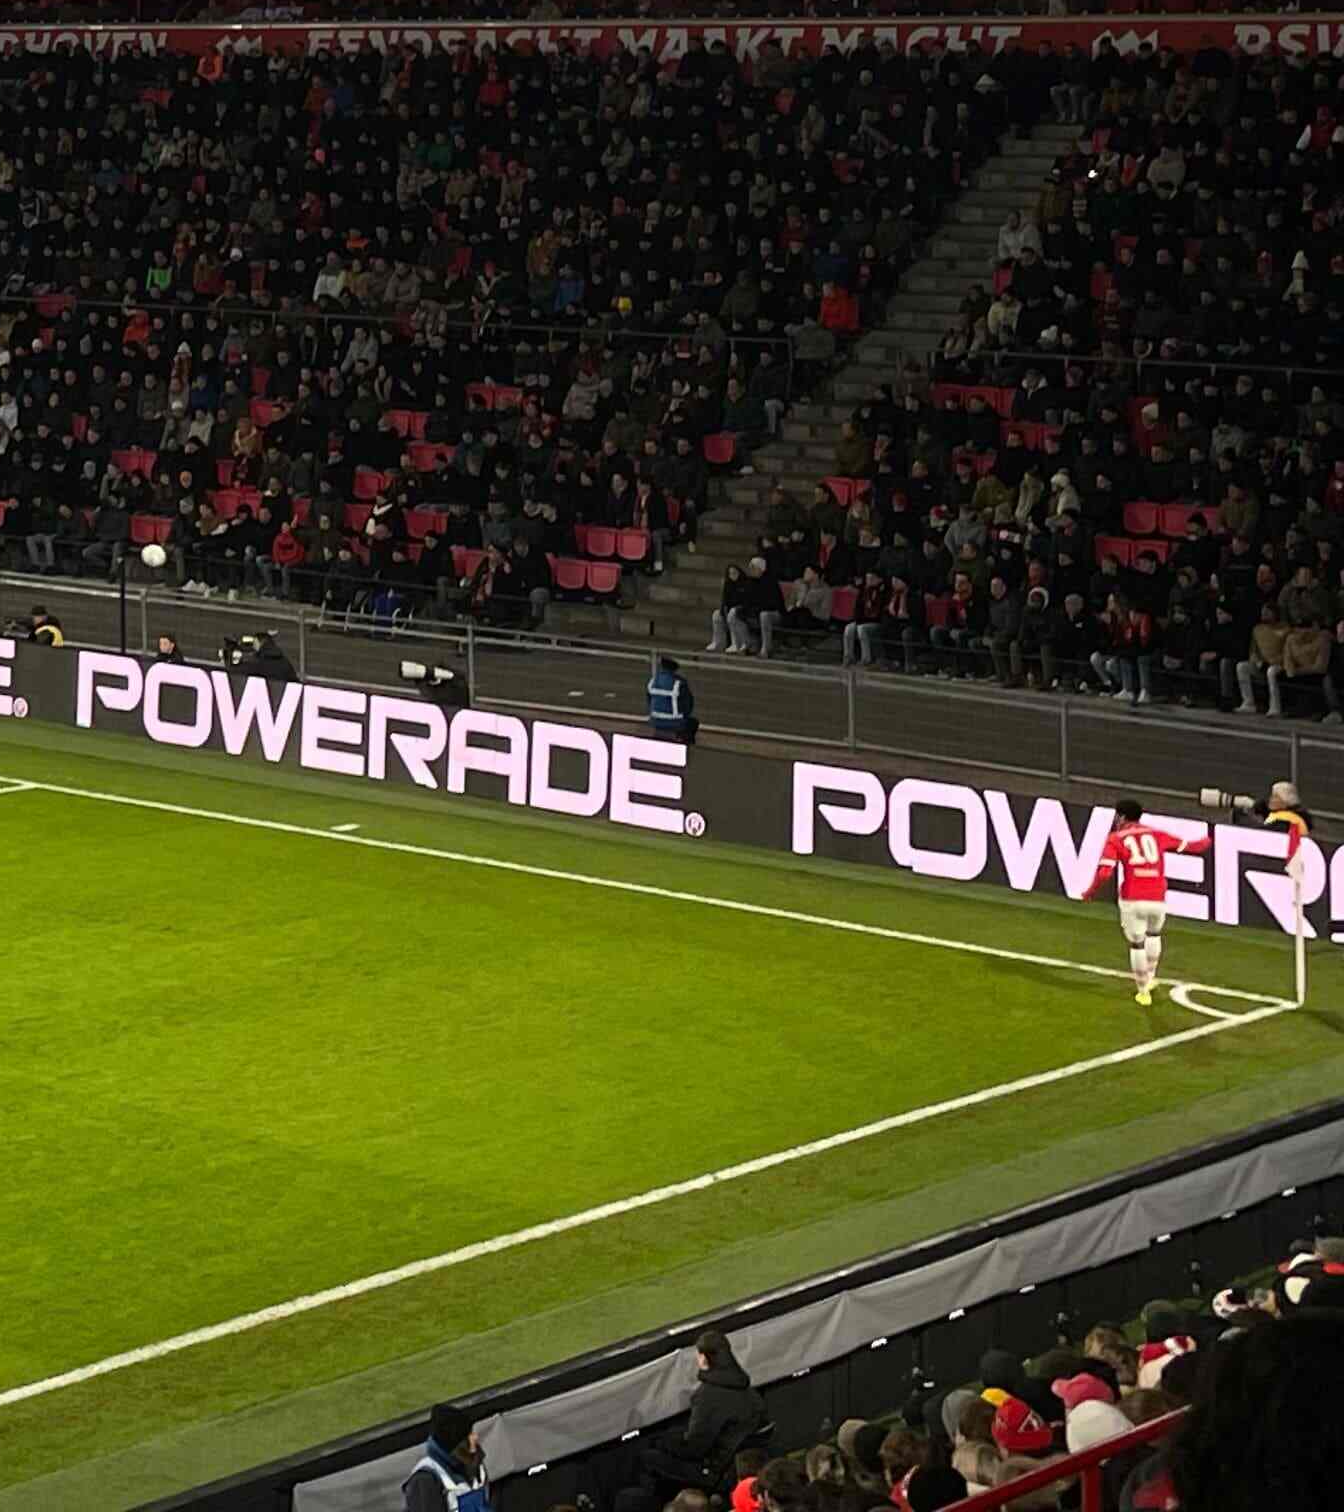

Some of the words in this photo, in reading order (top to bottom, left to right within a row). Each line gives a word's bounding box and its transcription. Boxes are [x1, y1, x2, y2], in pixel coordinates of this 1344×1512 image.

[76, 650, 688, 834] POWERADE
[793, 761, 1344, 942] POWER
[1123, 833, 1160, 865] 10
